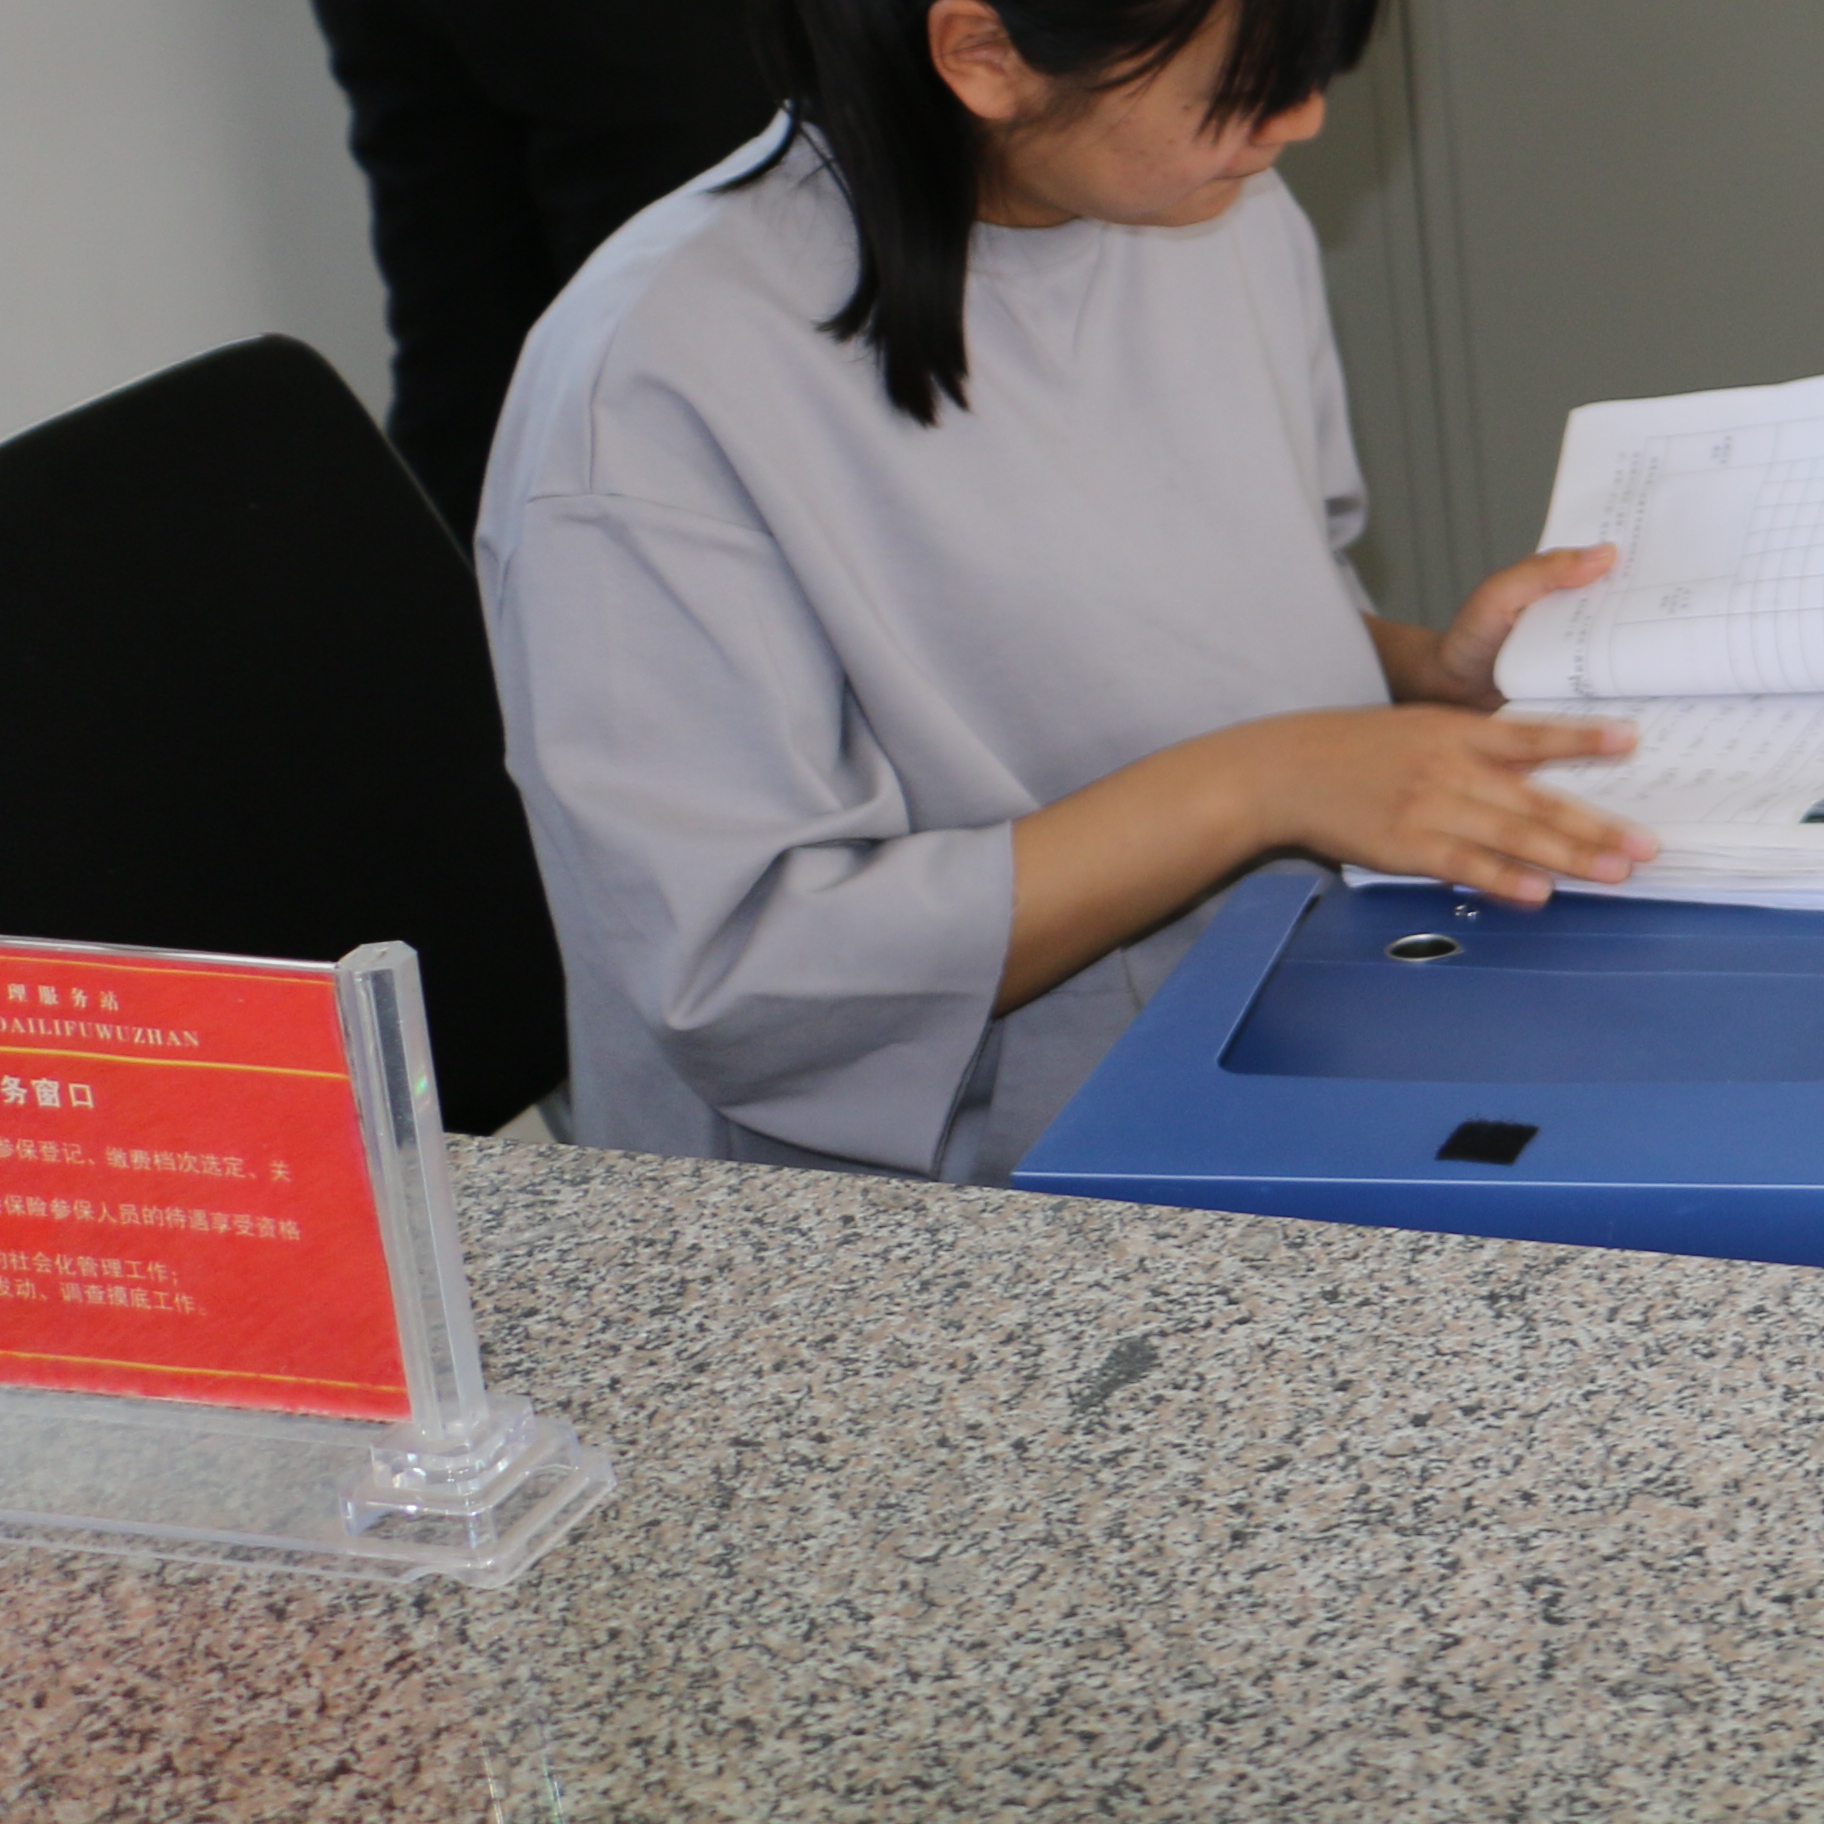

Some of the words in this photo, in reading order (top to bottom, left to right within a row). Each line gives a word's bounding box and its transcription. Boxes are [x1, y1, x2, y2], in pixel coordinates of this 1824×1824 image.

[7, 983, 119, 1012] 理服务站
[0, 1075, 95, 1108] 务窗口
[0, 1194, 301, 1240] 保险参保人员的待遇享受资格
